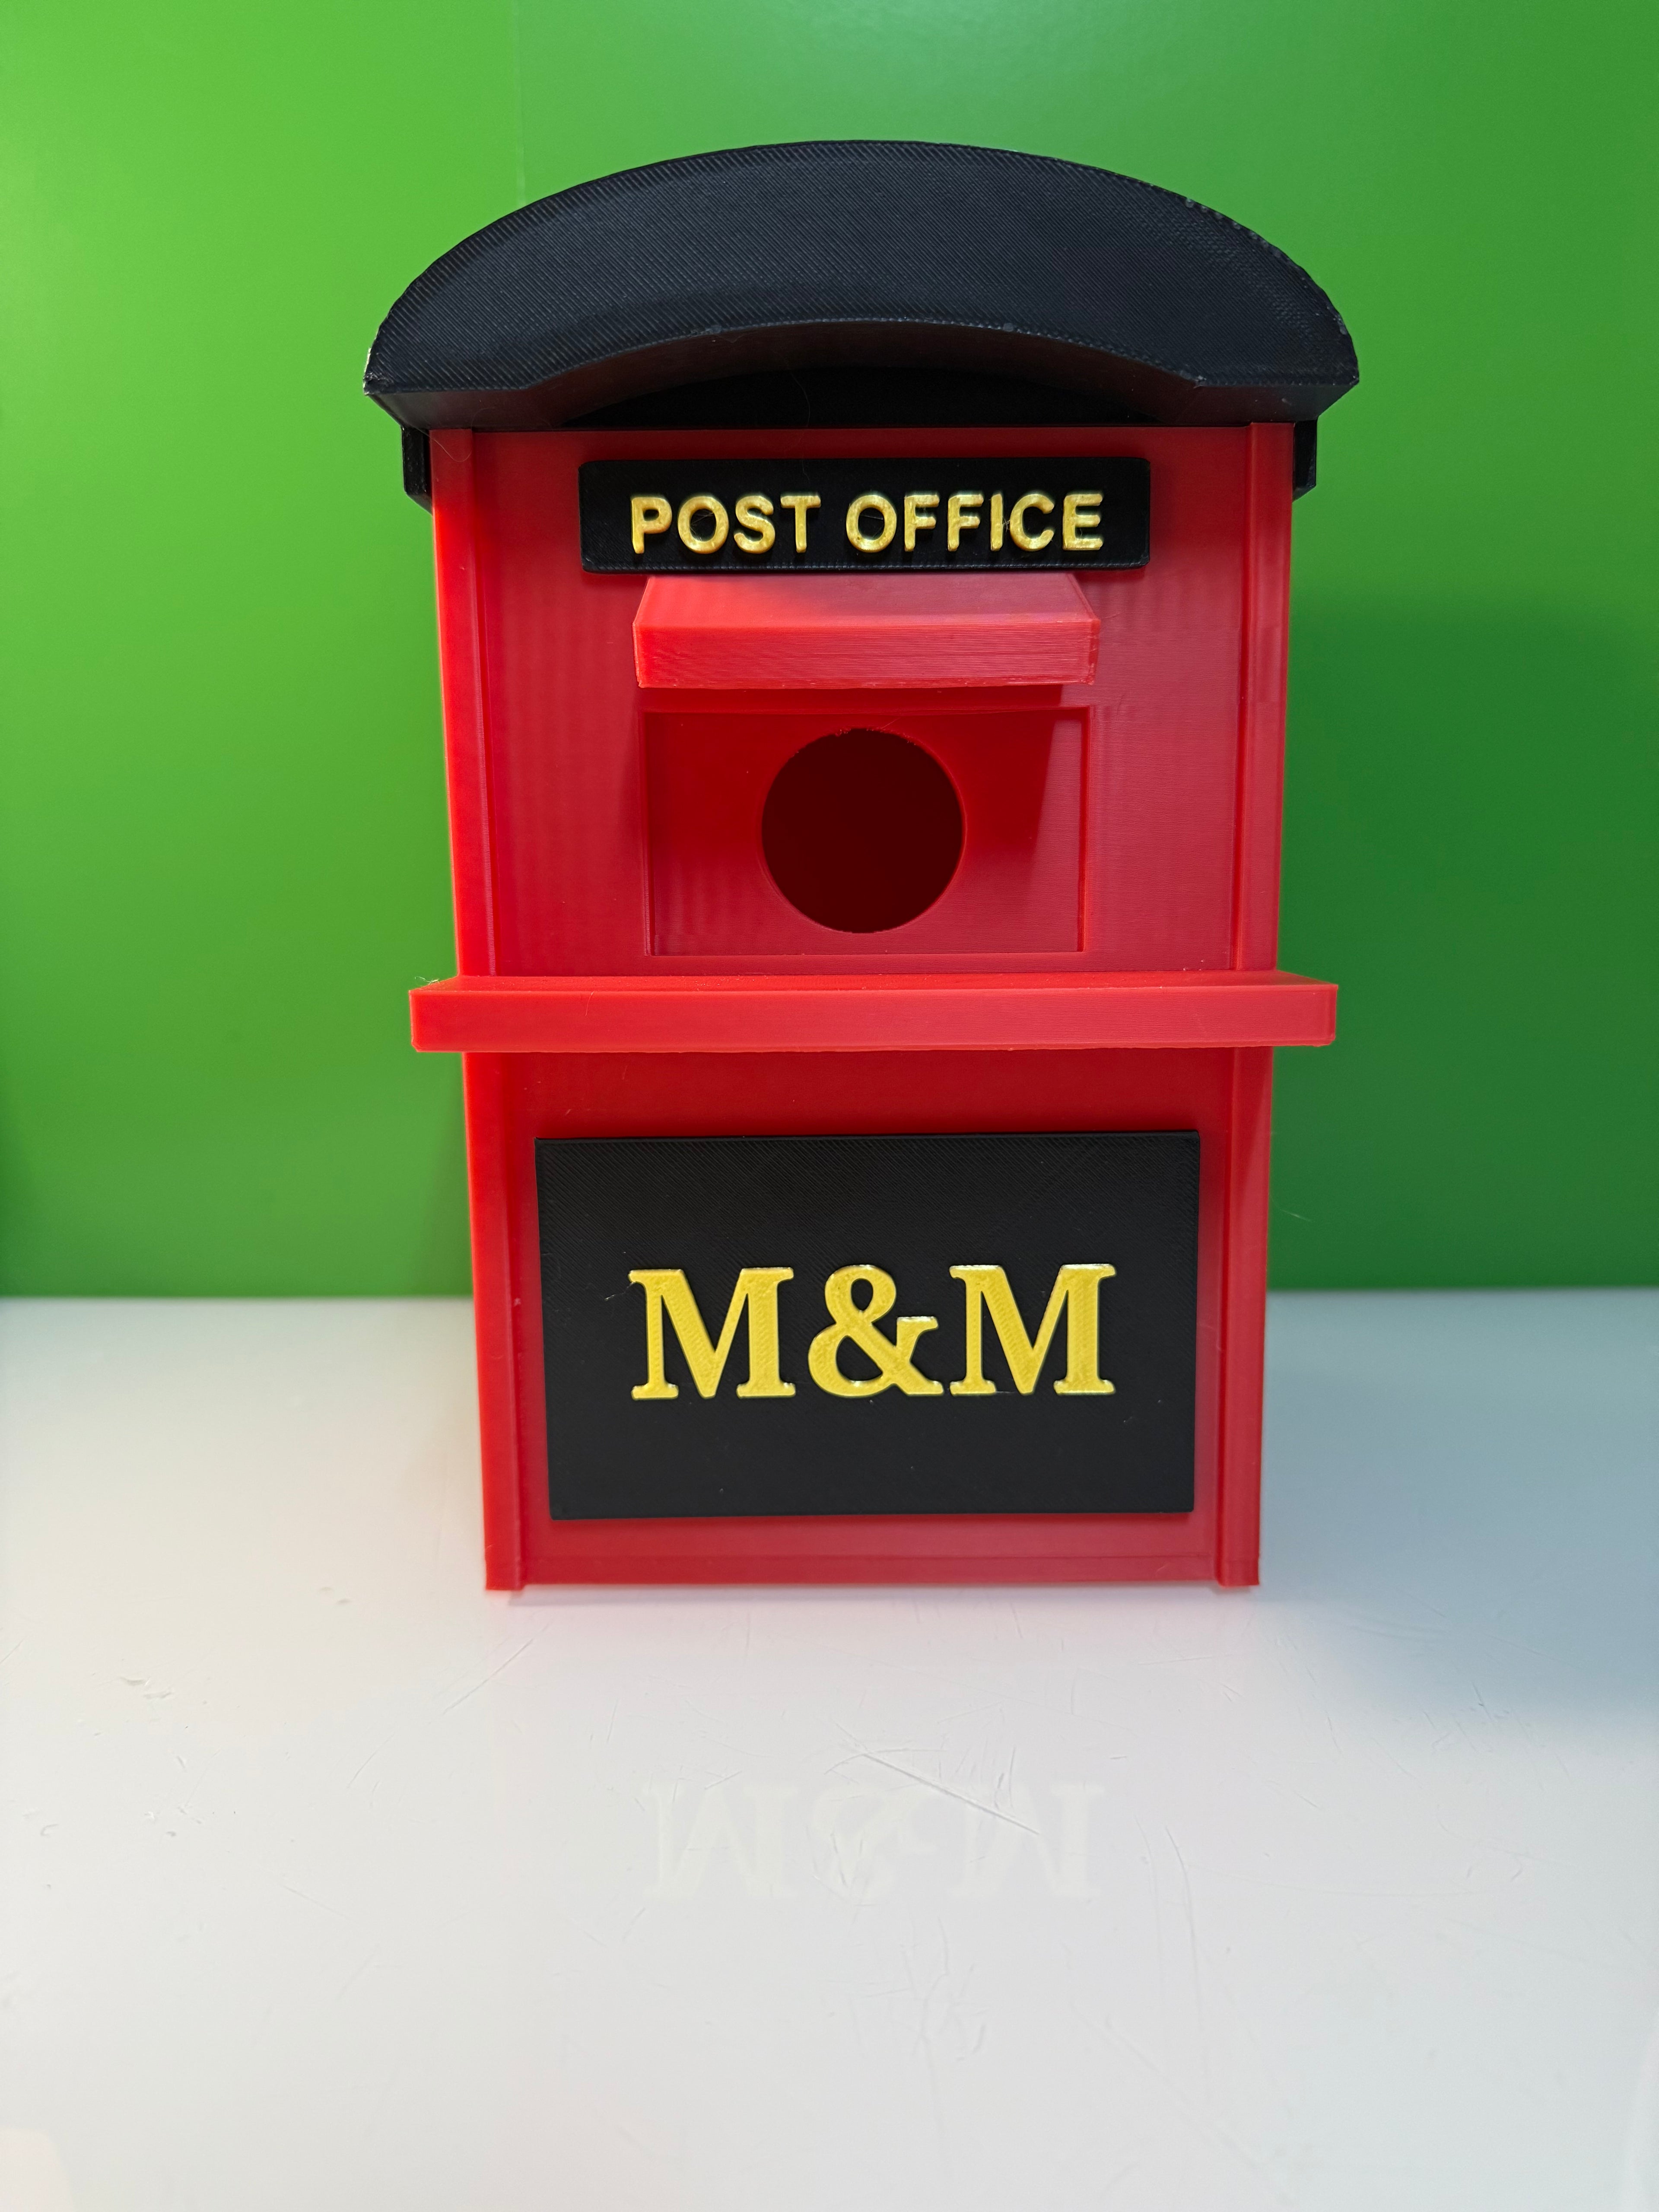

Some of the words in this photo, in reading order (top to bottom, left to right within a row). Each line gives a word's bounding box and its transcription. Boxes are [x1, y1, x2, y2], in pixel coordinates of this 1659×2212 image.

[630, 493, 821, 554] POST
[845, 493, 1103, 553] OFFICE
[627, 1264, 1116, 1400] M&M
